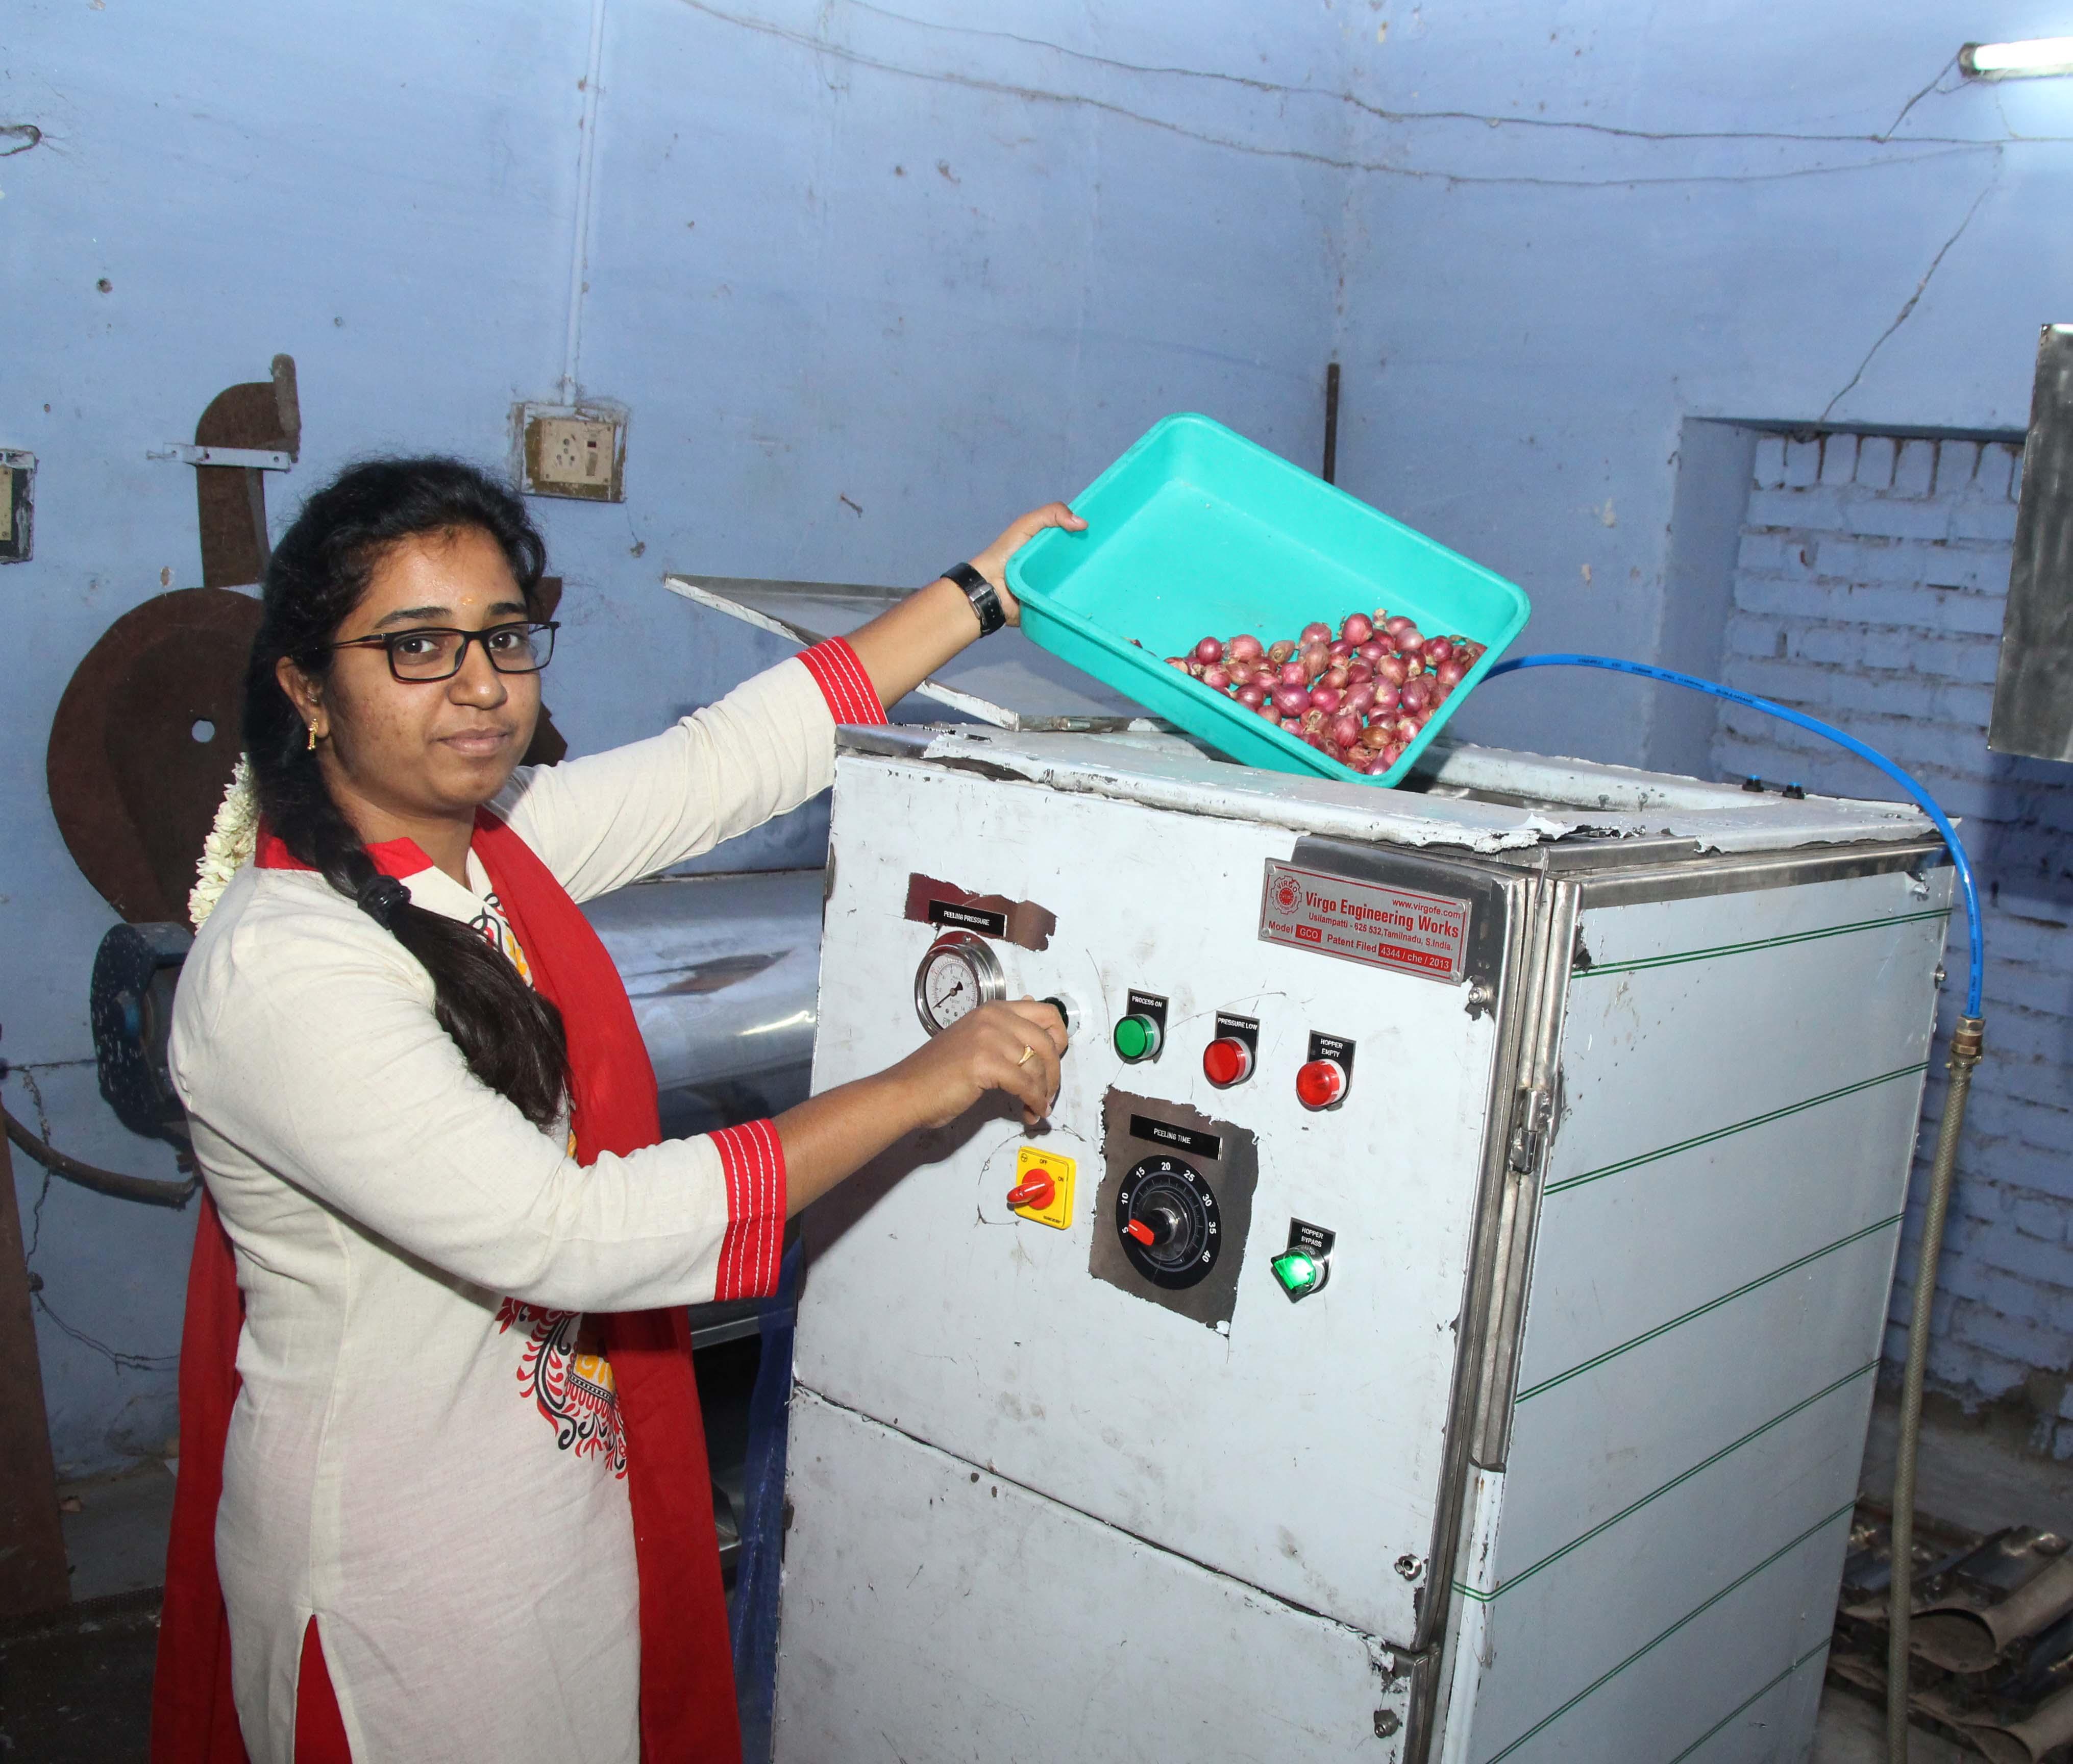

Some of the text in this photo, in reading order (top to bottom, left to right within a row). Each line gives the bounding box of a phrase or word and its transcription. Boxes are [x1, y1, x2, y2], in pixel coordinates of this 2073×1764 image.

[1276, 880, 1297, 892] VIRGO
[1306, 891, 1337, 913] Virgo
[1340, 899, 1414, 931] Engineering
[1418, 915, 1459, 938] Works
[1392, 899, 1460, 919] www.virgofe.com
[944, 910, 990, 926] PEELING PRESSURE
[1309, 912, 1348, 927] Usilampatti
[1354, 922, 1367, 932] 625
[1425, 938, 1453, 951] S.India.
[1269, 921, 1293, 934] Model
[1300, 928, 1318, 939] GCO
[1327, 934, 1353, 947] Patent
[1356, 941, 1376, 952] Filed
[1381, 947, 1400, 958] 4344
[1408, 953, 1422, 963] che
[1429, 957, 1449, 969] 2013
[1132, 995, 1154, 1006] PROCESS
[1218, 1017, 1258, 1031] PRESSURE LOW
[1320, 1038, 1343, 1049] HOPPER
[1321, 1048, 1340, 1058] EMPTY
[1154, 1128, 1191, 1144] PEELING TIME
[1136, 1167, 1145, 1178] 15
[1161, 1162, 1171, 1171] 20
[1183, 1170, 1195, 1182] 25
[1121, 1192, 1129, 1204] 10
[1202, 1193, 1212, 1207] 30
[1208, 1221, 1216, 1234] 35
[1302, 1227, 1323, 1239] HOPPER
[1301, 1236, 1322, 1247] BYPASS
[1202, 1249, 1211, 1263] 40
